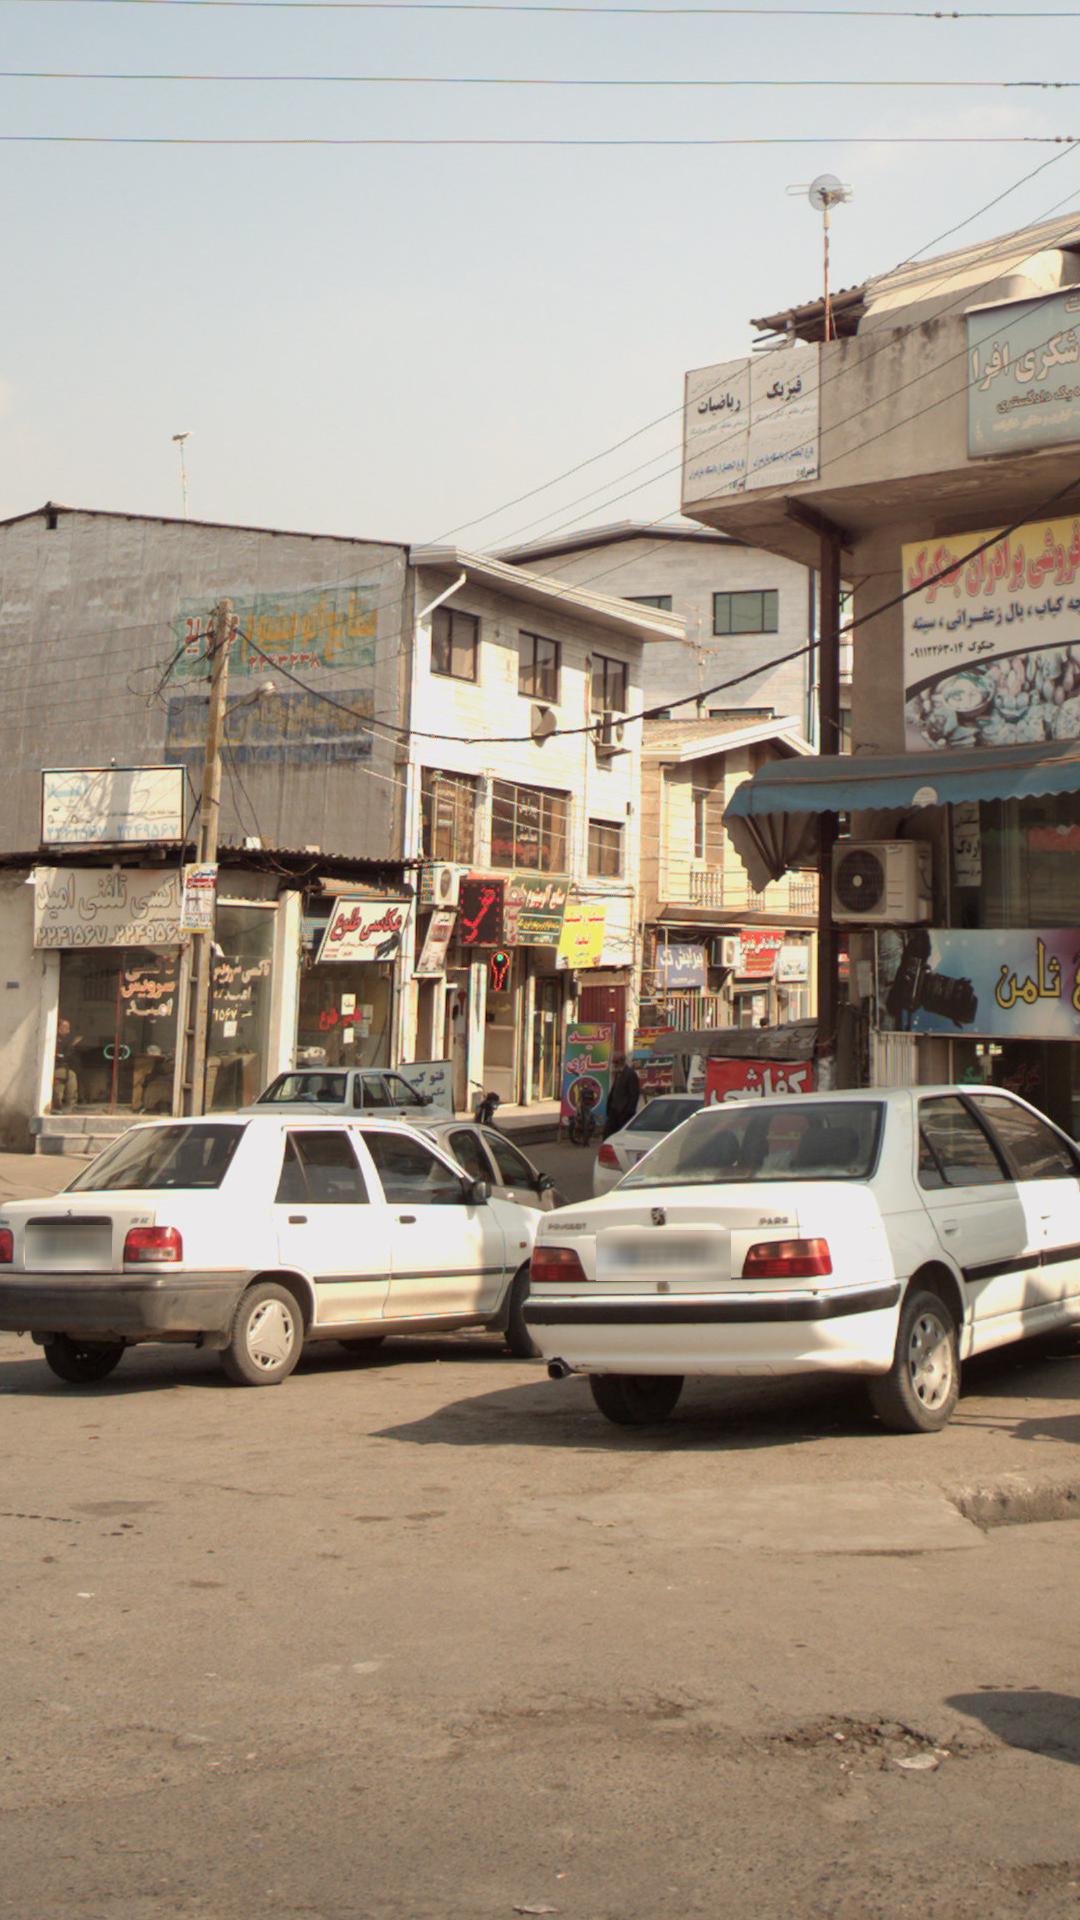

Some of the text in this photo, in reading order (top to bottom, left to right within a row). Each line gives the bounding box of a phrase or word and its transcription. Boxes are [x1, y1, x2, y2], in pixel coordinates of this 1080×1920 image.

[972, 341, 1010, 391] افرا
[766, 375, 803, 401] فیزیک
[697, 392, 742, 415] ریاضیات
[36, 873, 184, 921] اکسی تلفنی امید
[330, 906, 403, 942] عکاسی طلوع
[996, 937, 1062, 1009] ثامن
[121, 978, 176, 999] سرویس
[126, 998, 173, 1024] امید
[568, 1028, 610, 1050] کلید
[566, 1054, 609, 1075] سازی
